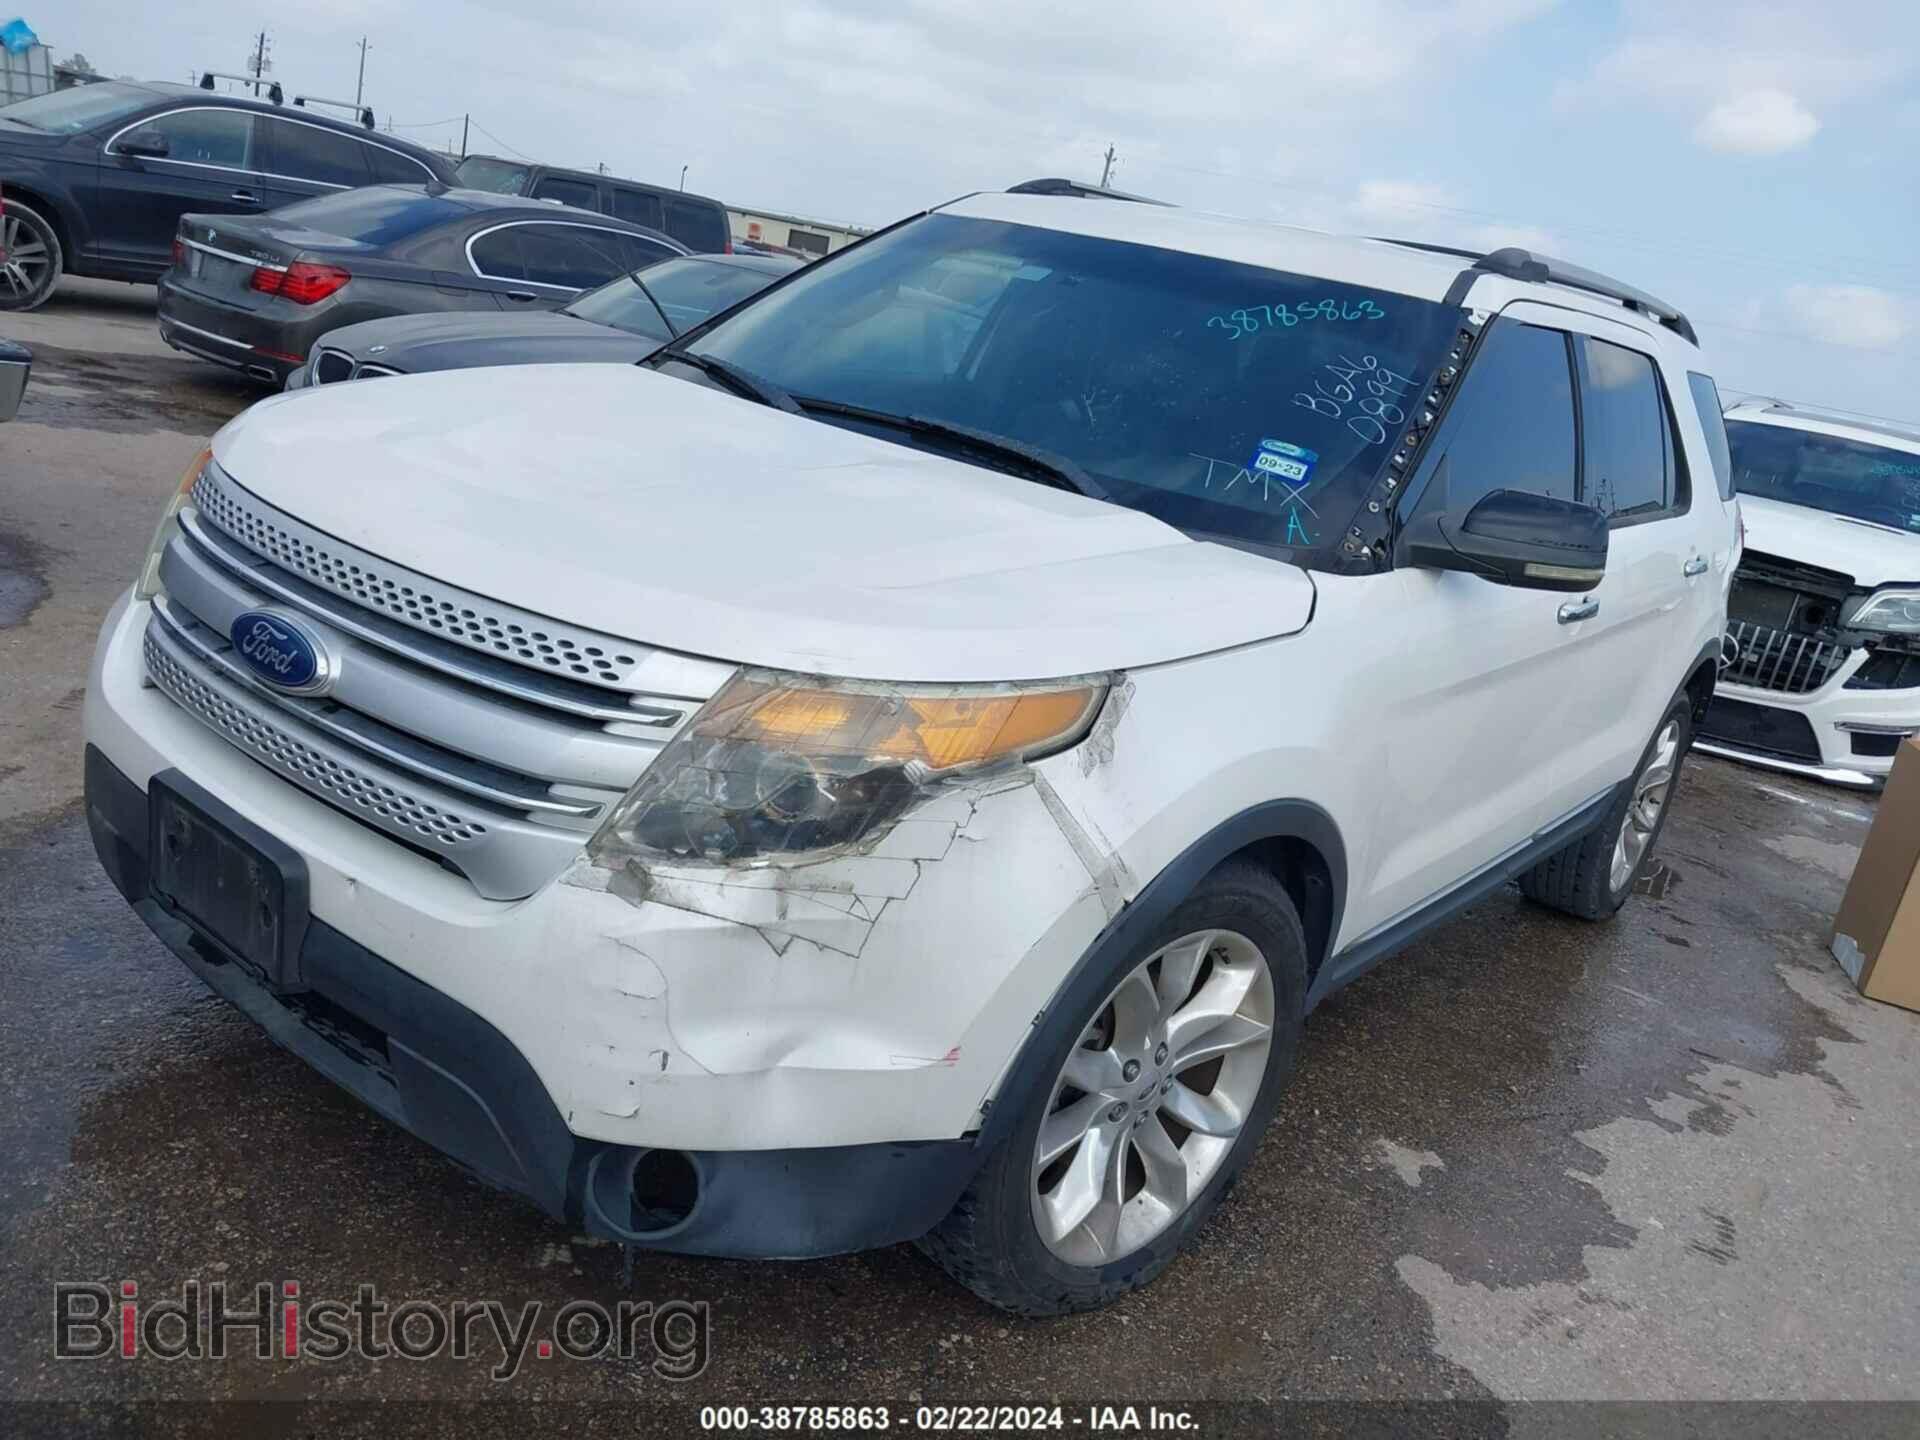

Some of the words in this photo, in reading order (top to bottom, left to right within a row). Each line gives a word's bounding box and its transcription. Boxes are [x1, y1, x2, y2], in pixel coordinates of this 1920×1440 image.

[1207, 299, 1385, 340] 38785863
[1346, 367, 1421, 445] 0899
[242, 620, 299, 674] Ford
